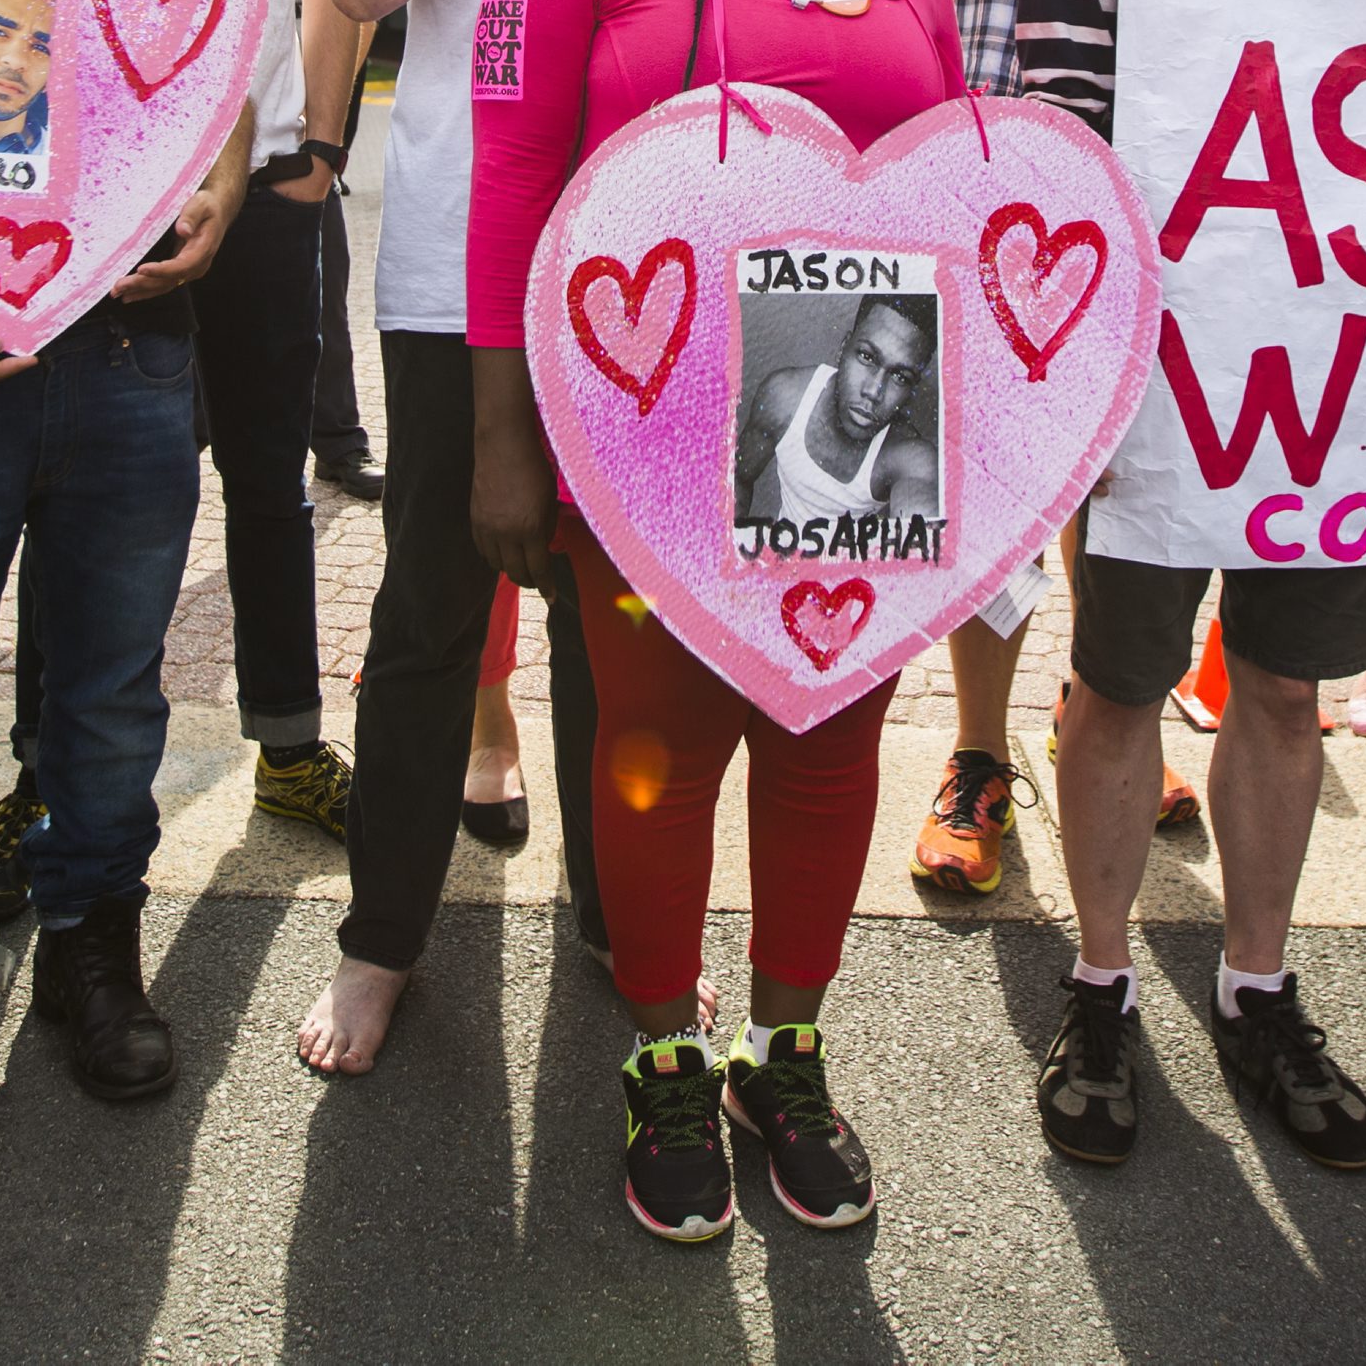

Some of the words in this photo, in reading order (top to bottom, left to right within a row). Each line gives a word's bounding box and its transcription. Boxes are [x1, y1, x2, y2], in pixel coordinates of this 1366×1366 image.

[480, 0, 524, 19] MAKE
[477, 19, 523, 41] OUT
[476, 41, 522, 64] NOT
[475, 64, 519, 86] WAR
[747, 249, 900, 292] JASON
[734, 510, 948, 566] JOSAPHAT
